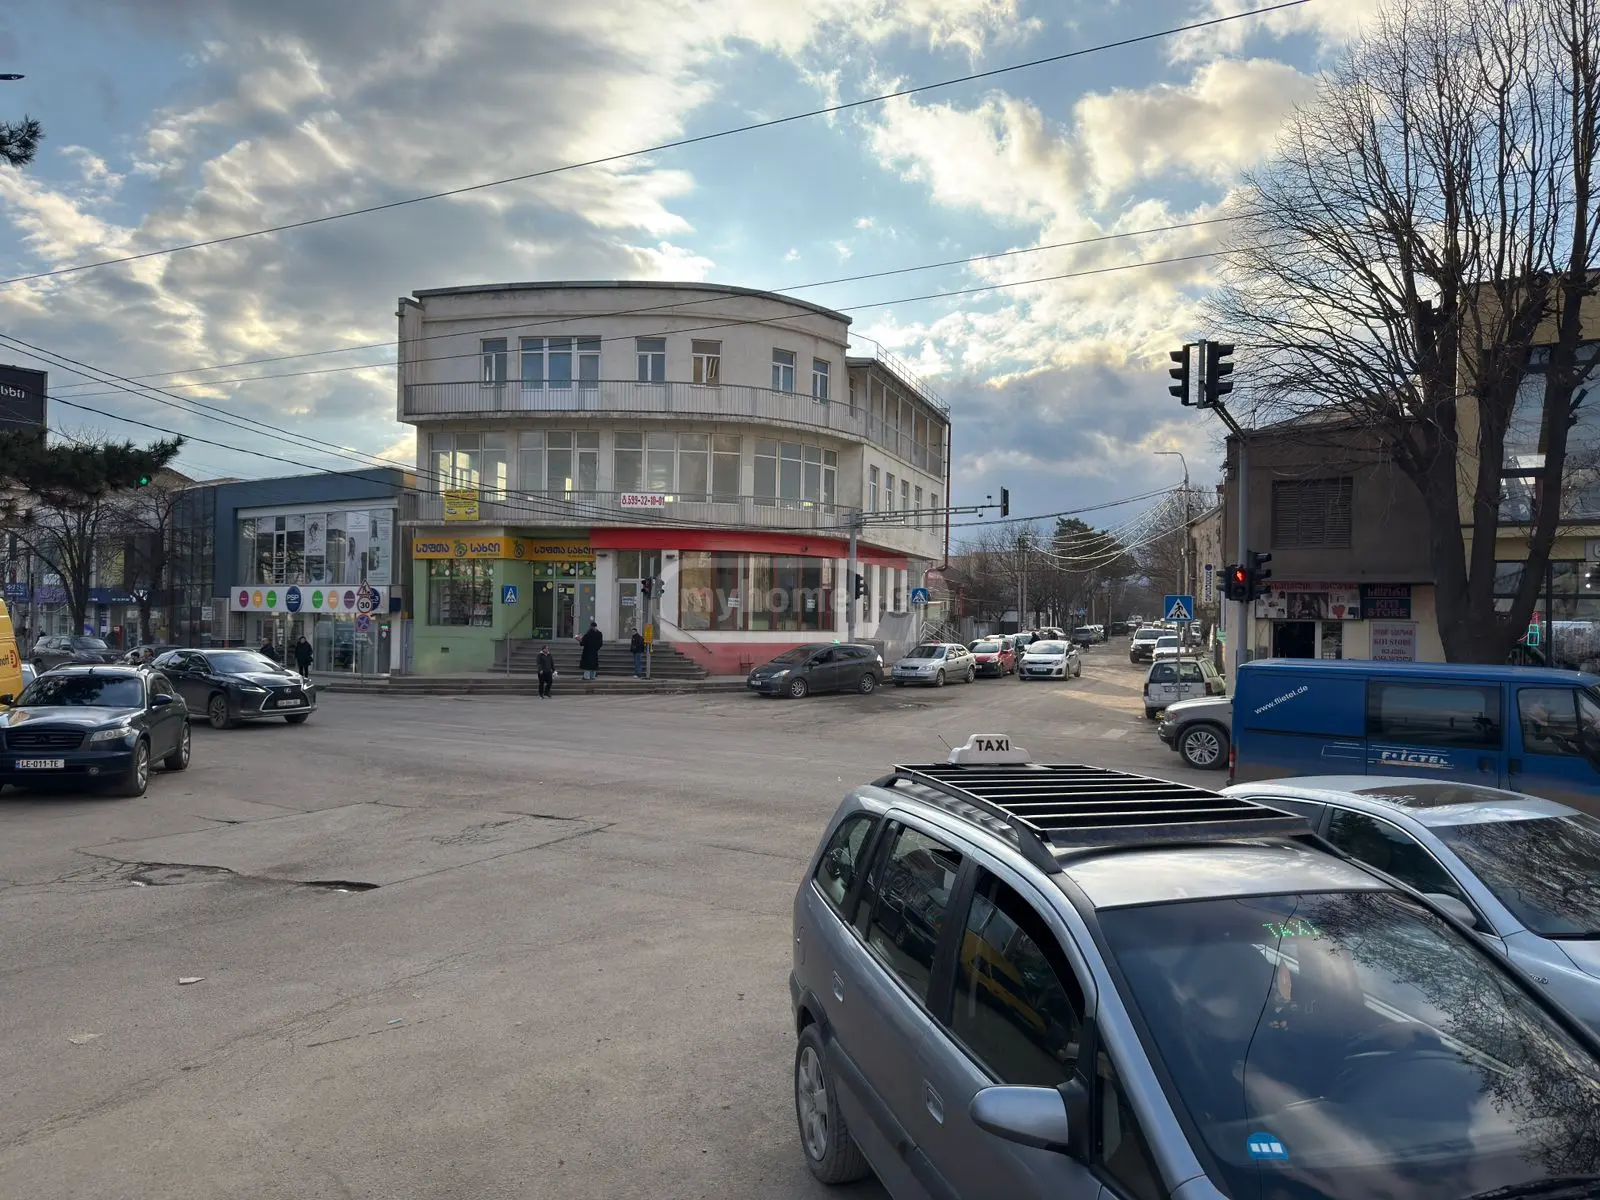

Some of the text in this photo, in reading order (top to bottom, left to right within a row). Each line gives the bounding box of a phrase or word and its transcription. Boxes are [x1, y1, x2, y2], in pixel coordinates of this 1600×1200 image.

[415, 542, 501, 553] სუფთა სახლი
[533, 546, 566, 554] სუფთა
[360, 601, 370, 609] 30
[1367, 608, 1408, 617] STORE
[975, 739, 1010, 752] TAXI
